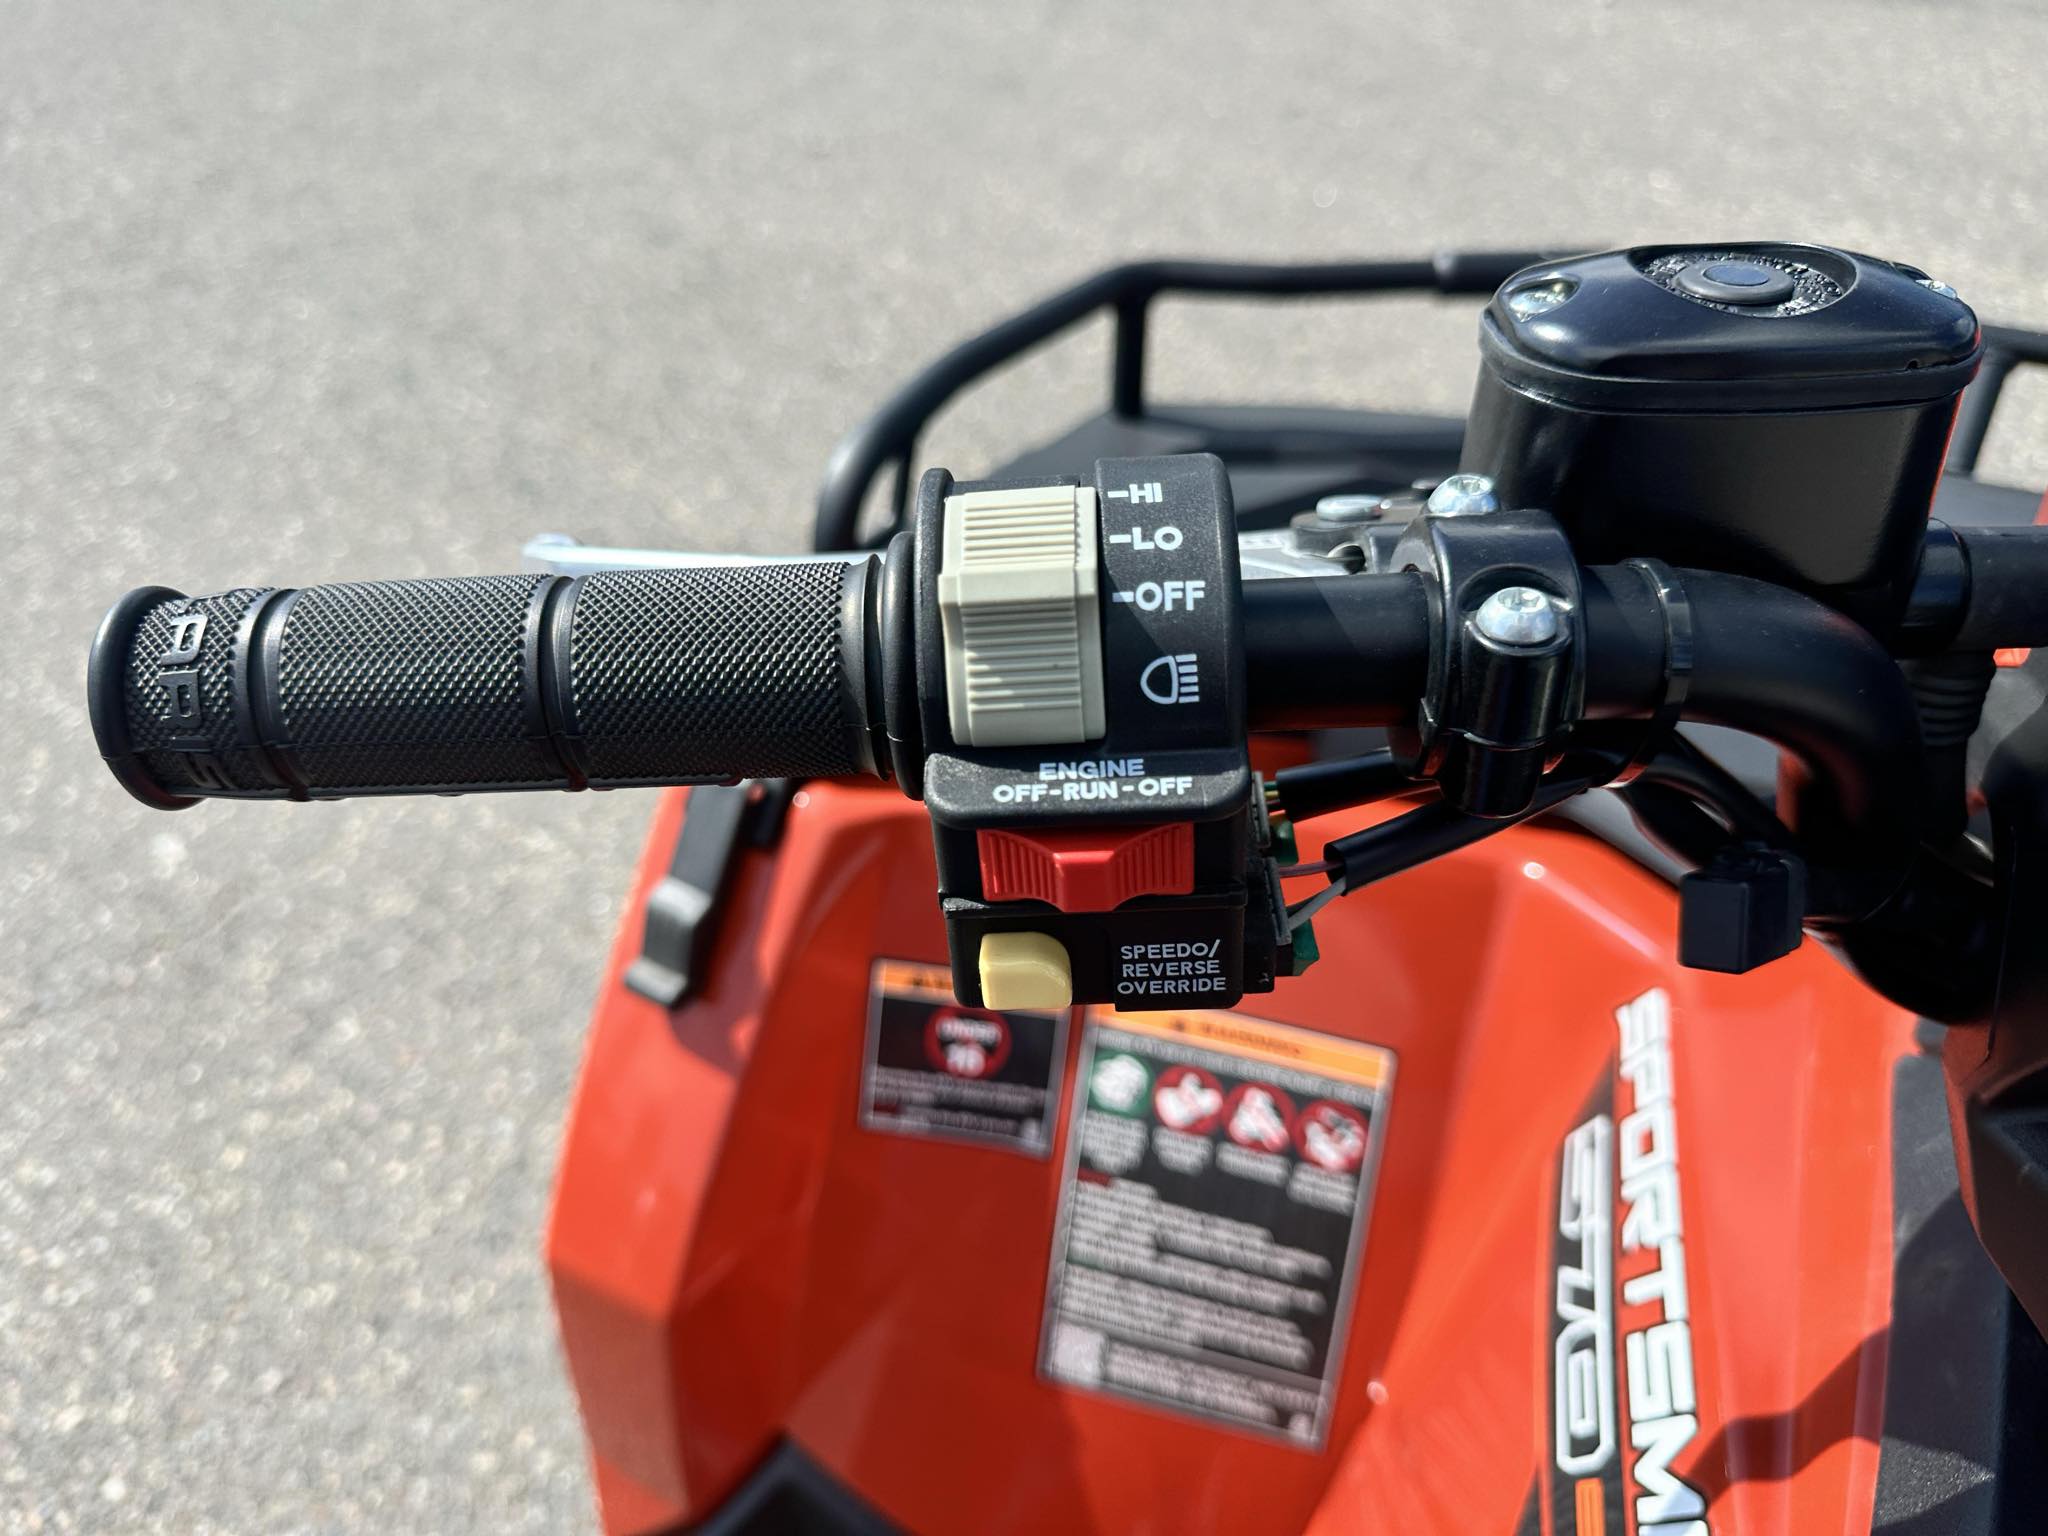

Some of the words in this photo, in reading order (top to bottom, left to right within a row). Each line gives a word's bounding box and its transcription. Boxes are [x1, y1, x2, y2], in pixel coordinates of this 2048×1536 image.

[1132, 526, 1183, 551] LO
[1135, 580, 1206, 612] OFF
[1039, 758, 1145, 781] ENGINE
[1120, 939, 1221, 960] SPEEDO/
[1122, 960, 1221, 978] REVERSE
[1117, 977, 1227, 995] OVERRIDE
[1616, 987, 1710, 1536] SPORTSM
[1556, 1114, 1615, 1476] 570
